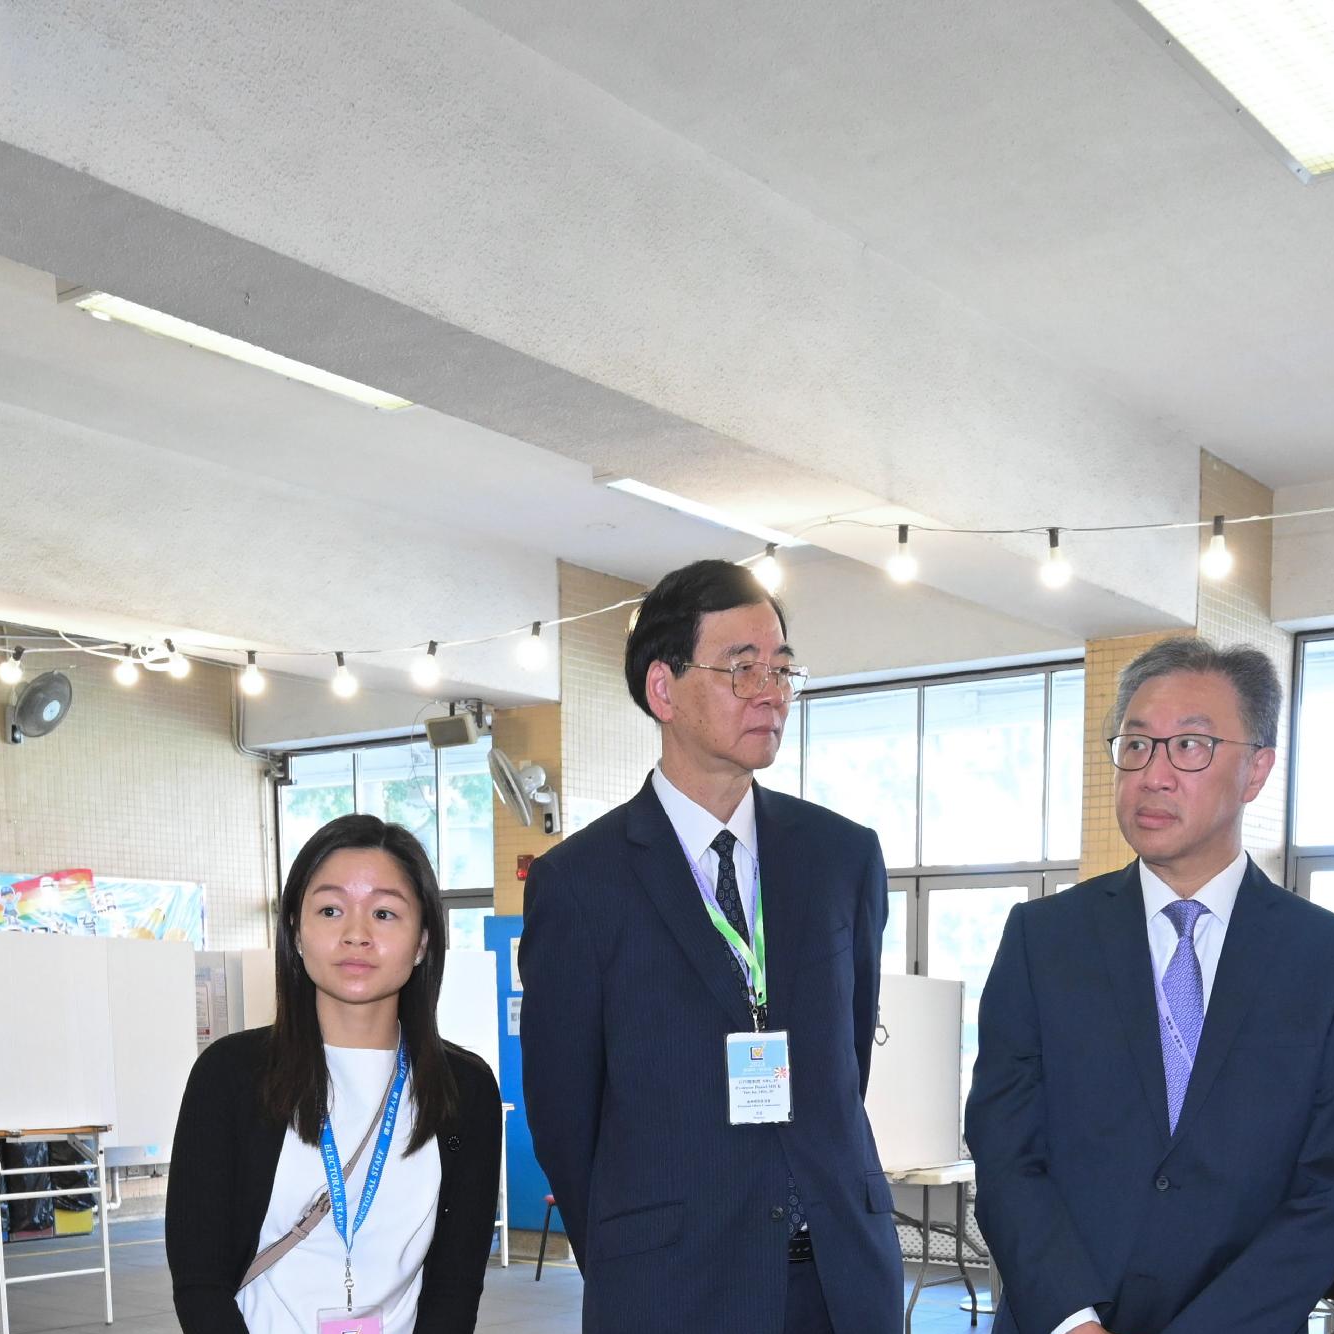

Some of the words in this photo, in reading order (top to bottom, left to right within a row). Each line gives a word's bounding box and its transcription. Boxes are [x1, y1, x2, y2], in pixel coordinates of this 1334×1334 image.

[324, 1143, 343, 1200] ELECTORAL
[334, 1201, 344, 1229] STAFF
[370, 1148, 385, 1177] STAFF
